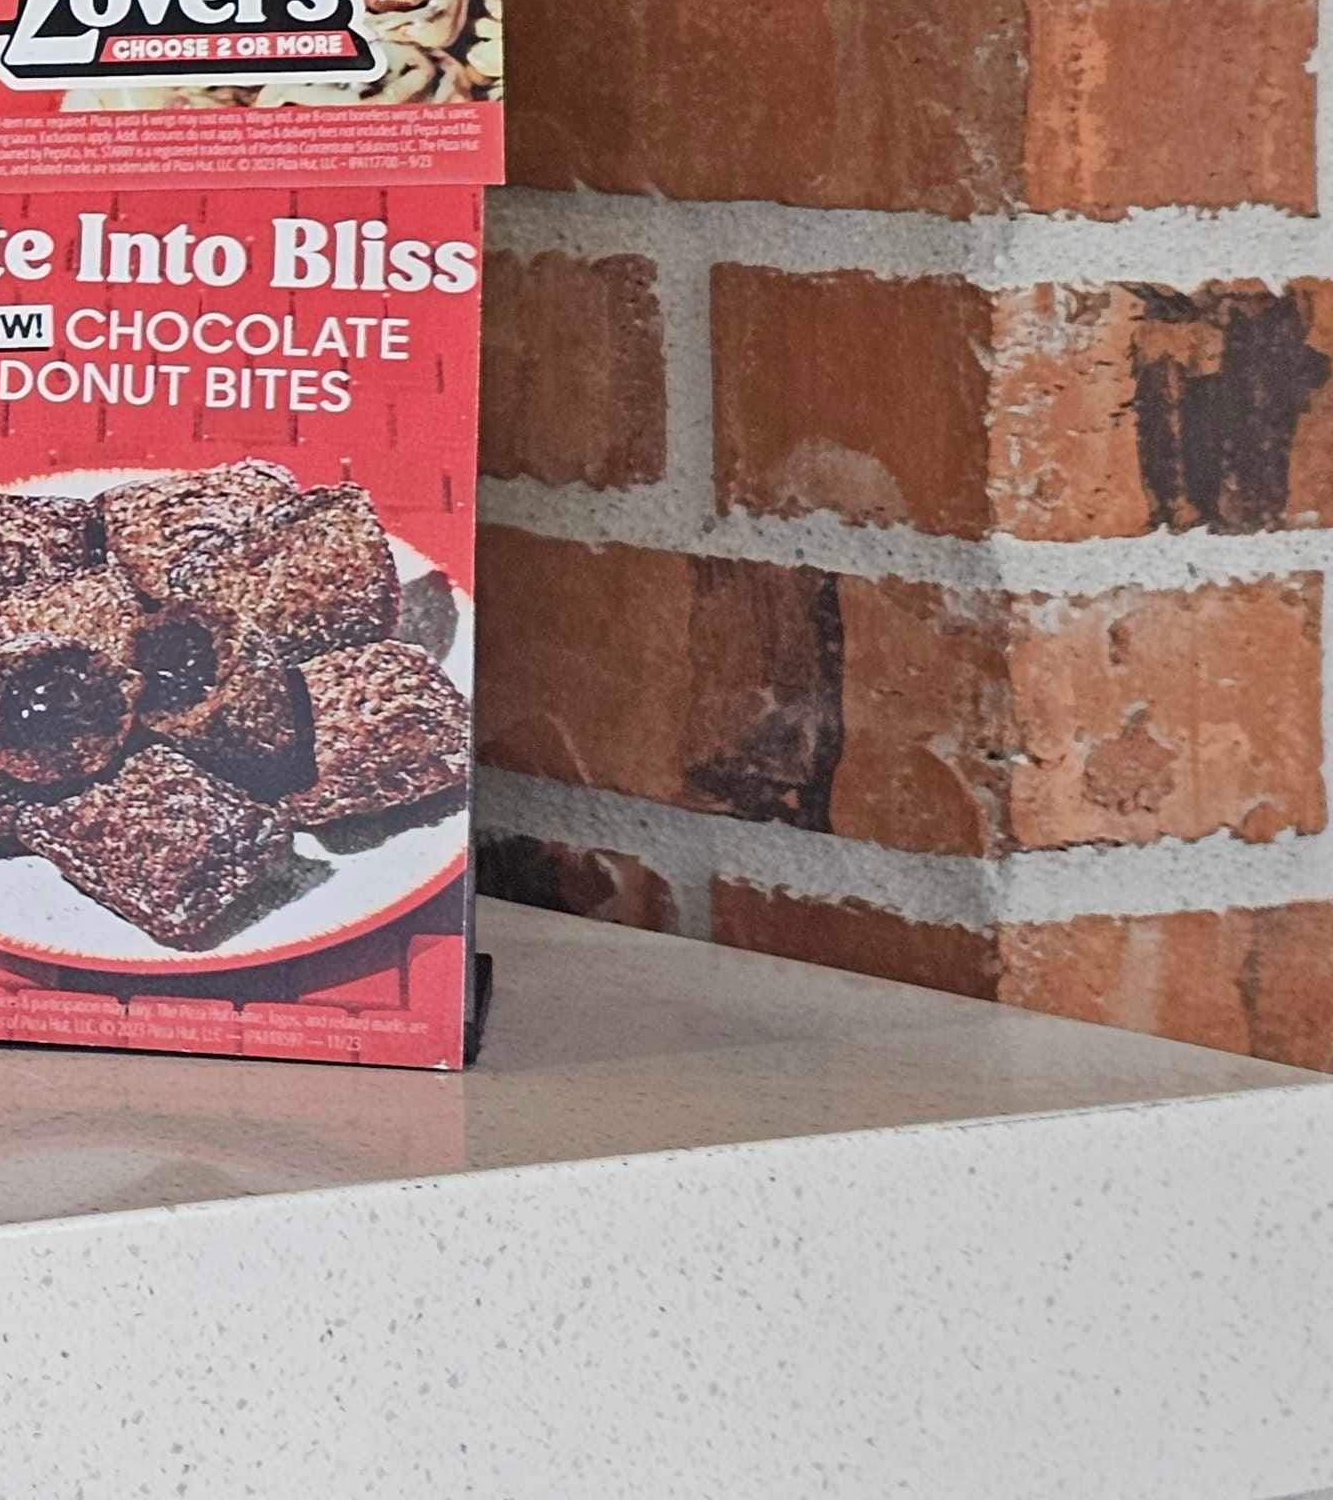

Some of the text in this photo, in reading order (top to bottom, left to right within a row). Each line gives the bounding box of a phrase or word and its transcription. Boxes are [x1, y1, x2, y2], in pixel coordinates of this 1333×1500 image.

[111, 34, 343, 61] CHOOSE 2 OR MORE
[75, 212, 248, 288] Into
[269, 217, 479, 294] Bliss
[64, 308, 412, 361] CHOCOLATE
[204, 365, 353, 414] BITES
